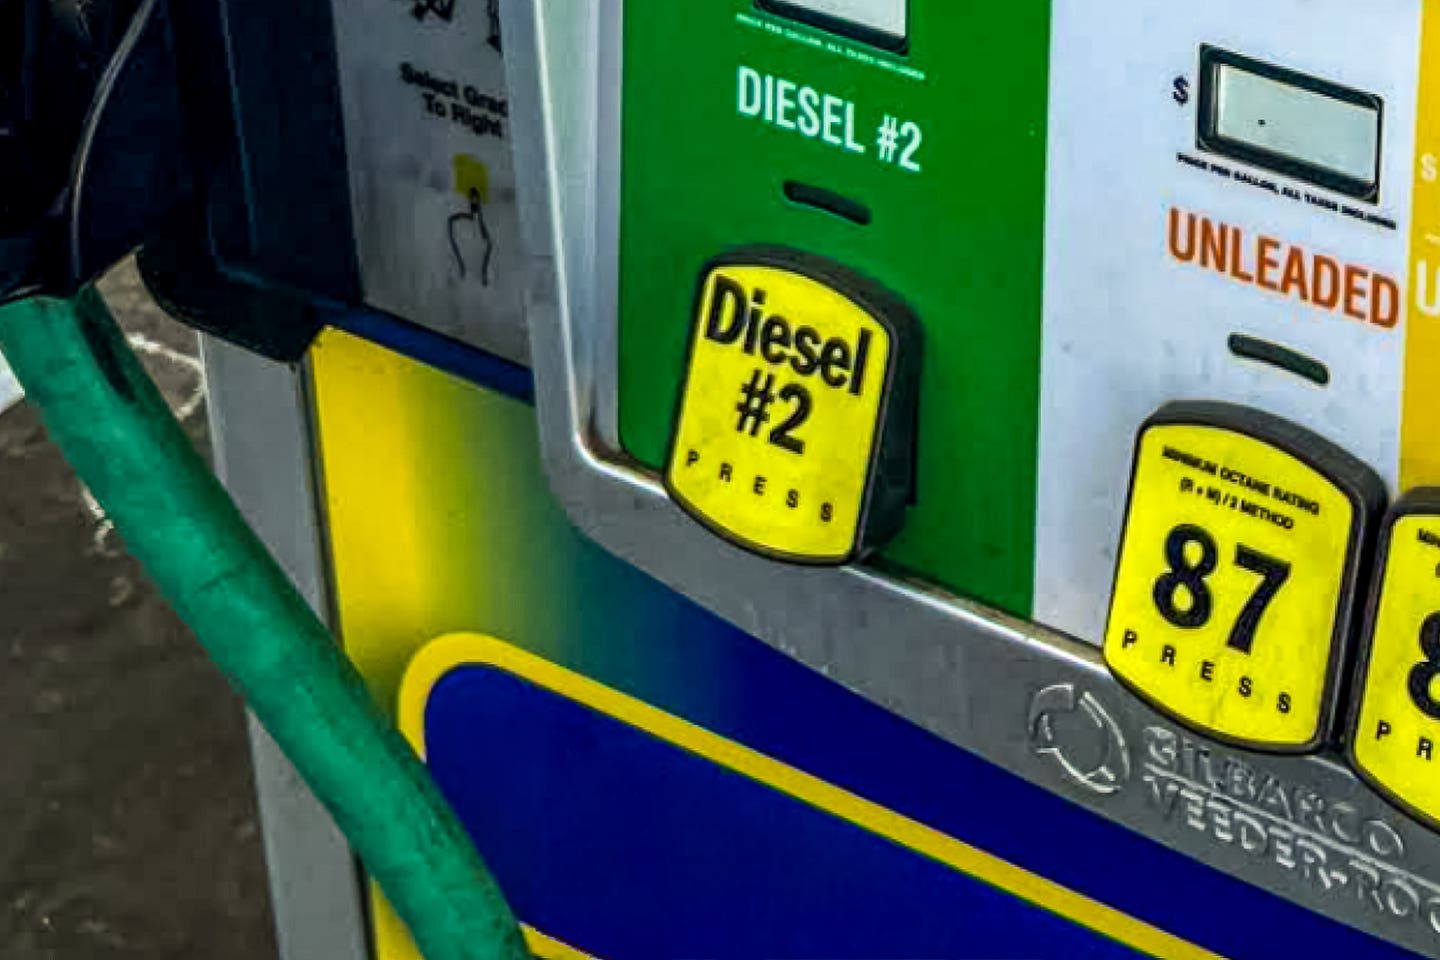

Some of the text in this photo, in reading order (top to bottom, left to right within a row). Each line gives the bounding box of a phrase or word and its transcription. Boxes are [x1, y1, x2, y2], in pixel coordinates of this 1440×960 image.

[400, 62, 460, 98] Select
[422, 92, 503, 139] To Right
[737, 65, 923, 172] DIESEL #2
[1172, 74, 1190, 107] $
[1420, 152, 1437, 182] $
[1166, 206, 1400, 330] UNLEADED
[704, 275, 874, 397] Diesel
[735, 369, 814, 455] #2
[1152, 523, 1293, 656] 87
[1143, 726, 1404, 856] GILBARCO
